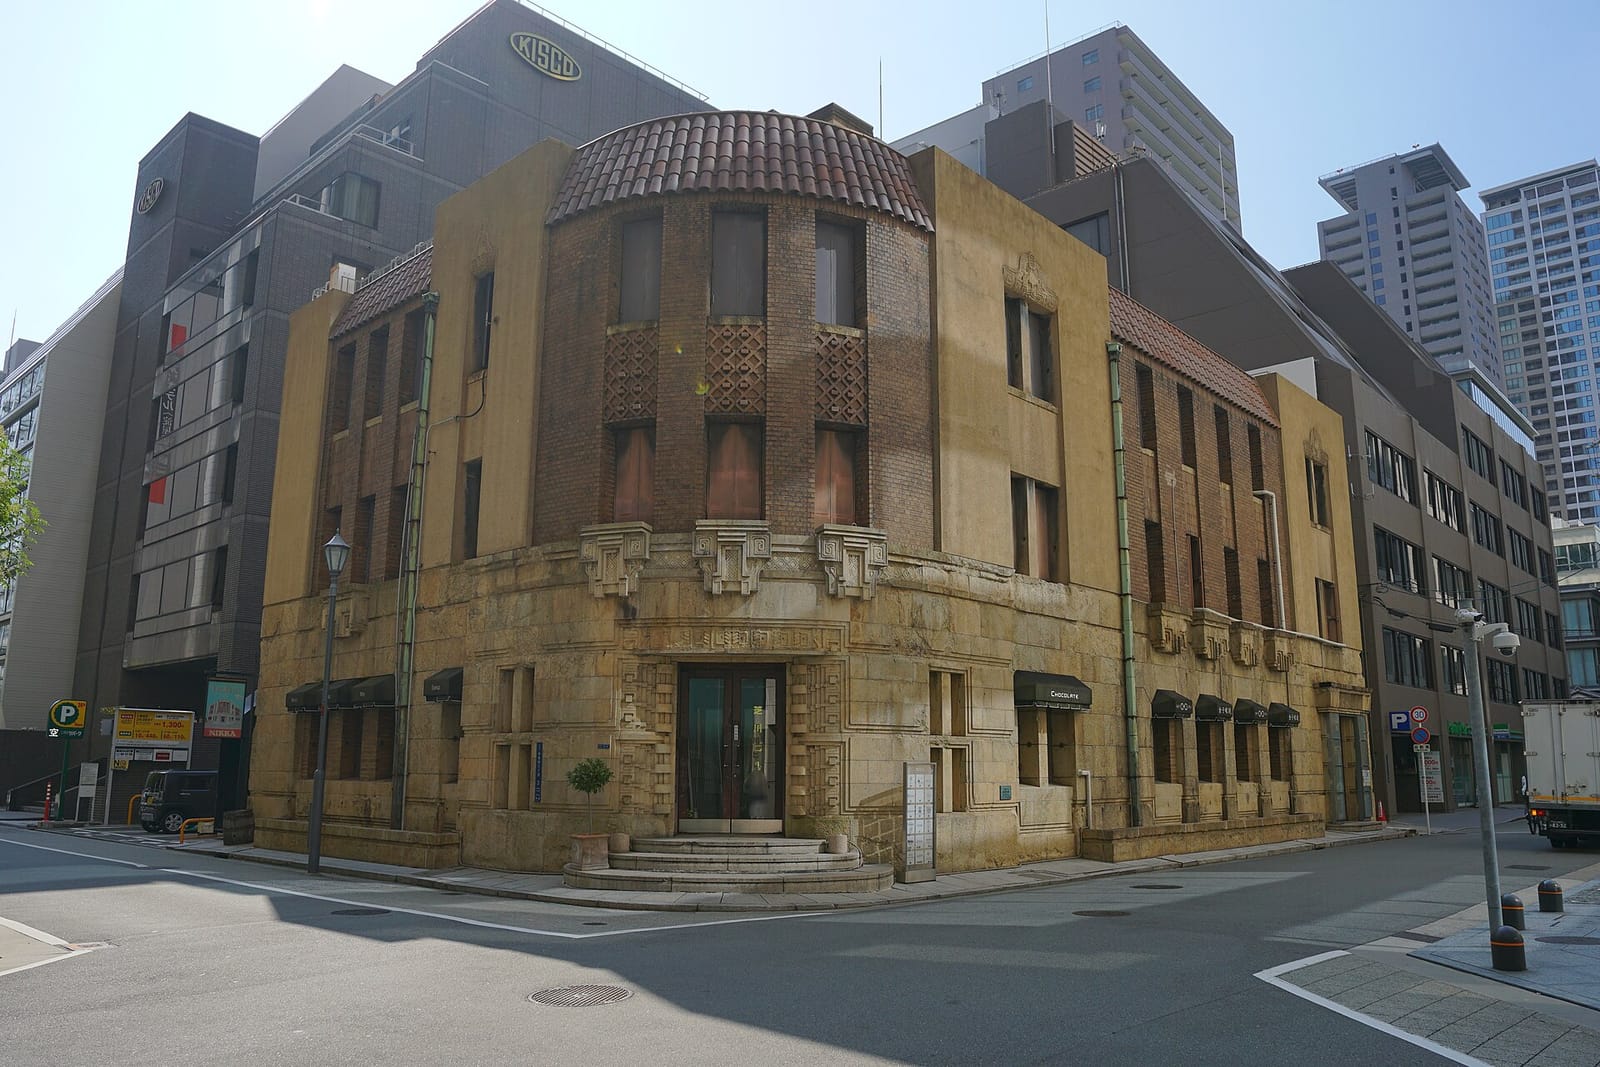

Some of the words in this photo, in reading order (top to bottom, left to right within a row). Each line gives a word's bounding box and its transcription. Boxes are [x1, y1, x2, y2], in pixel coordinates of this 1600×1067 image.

[519, 36, 574, 75] KISCO
[60, 705, 76, 723] P
[1414, 710, 1424, 719] 30
[1392, 713, 1408, 729] P
[48, 728, 59, 738] 空
[209, 729, 236, 737] NIKKA
